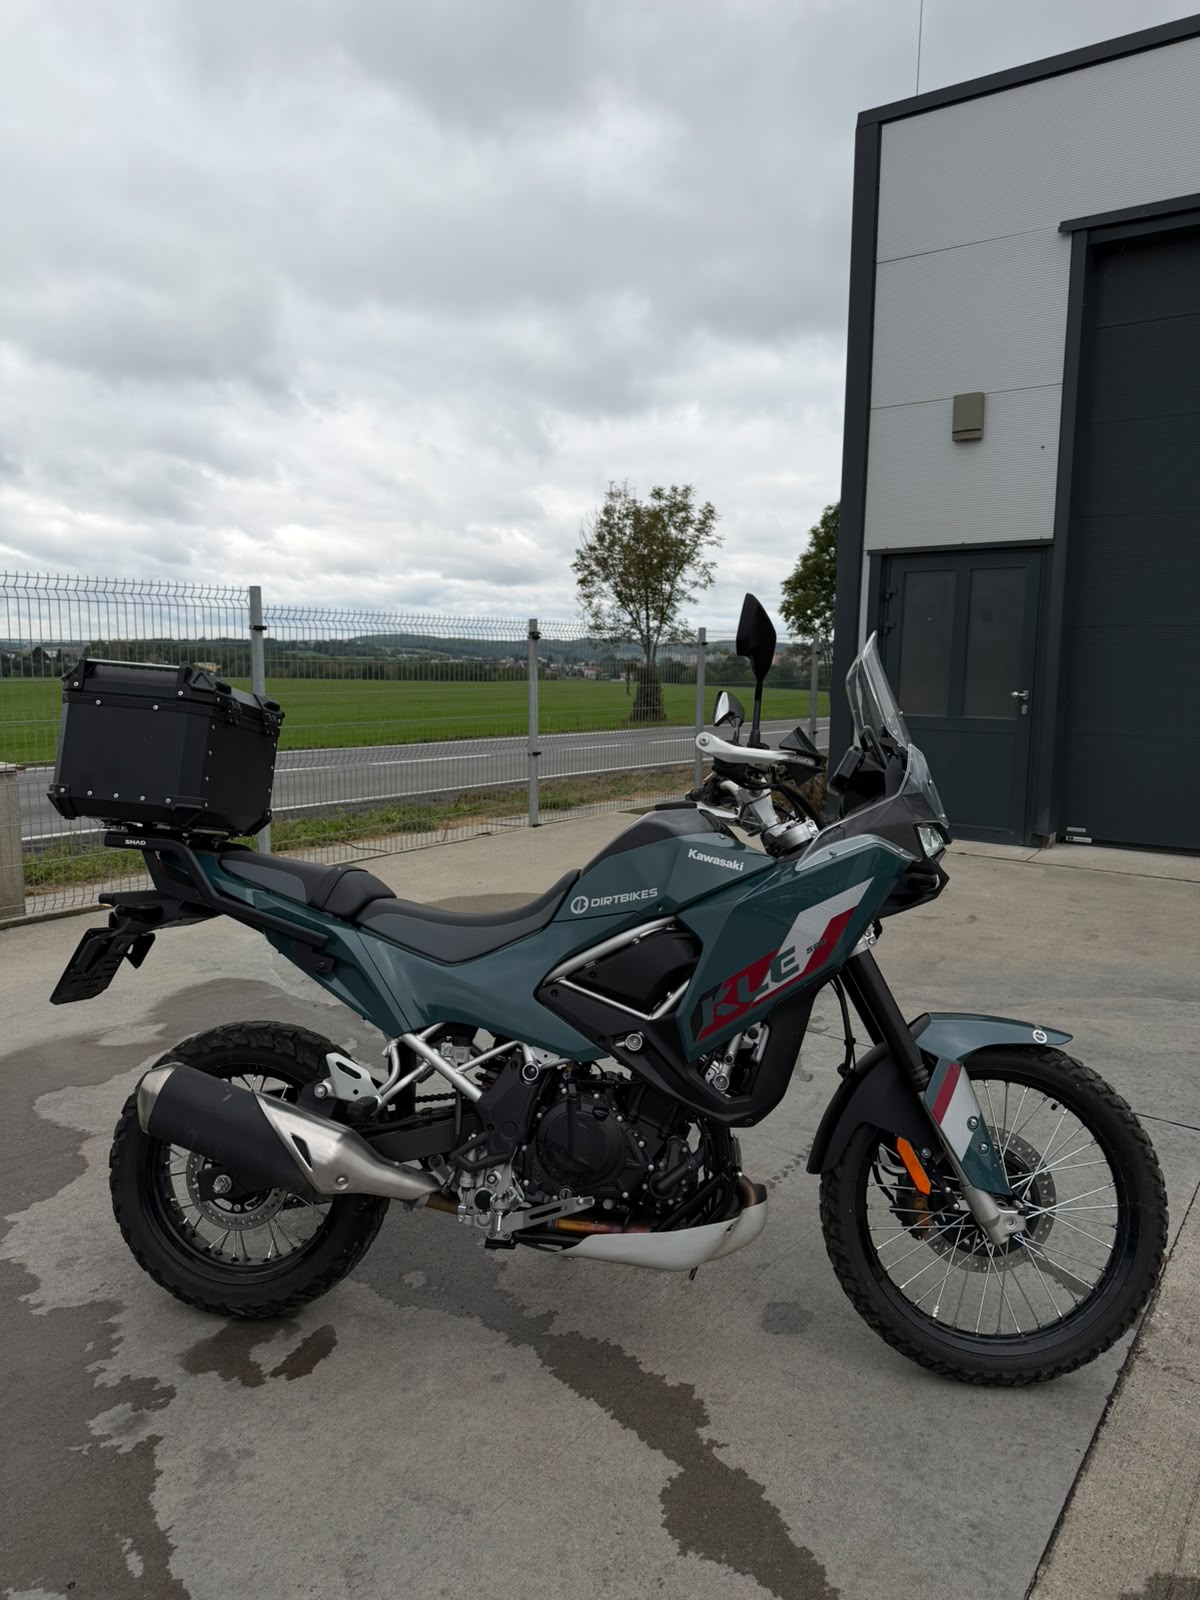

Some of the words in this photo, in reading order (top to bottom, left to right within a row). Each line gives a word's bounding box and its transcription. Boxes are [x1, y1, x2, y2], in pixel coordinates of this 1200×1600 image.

[688, 848, 744, 871] Kawasaki
[591, 888, 658, 907] DIRTBIKES
[702, 945, 800, 1031] KLE
